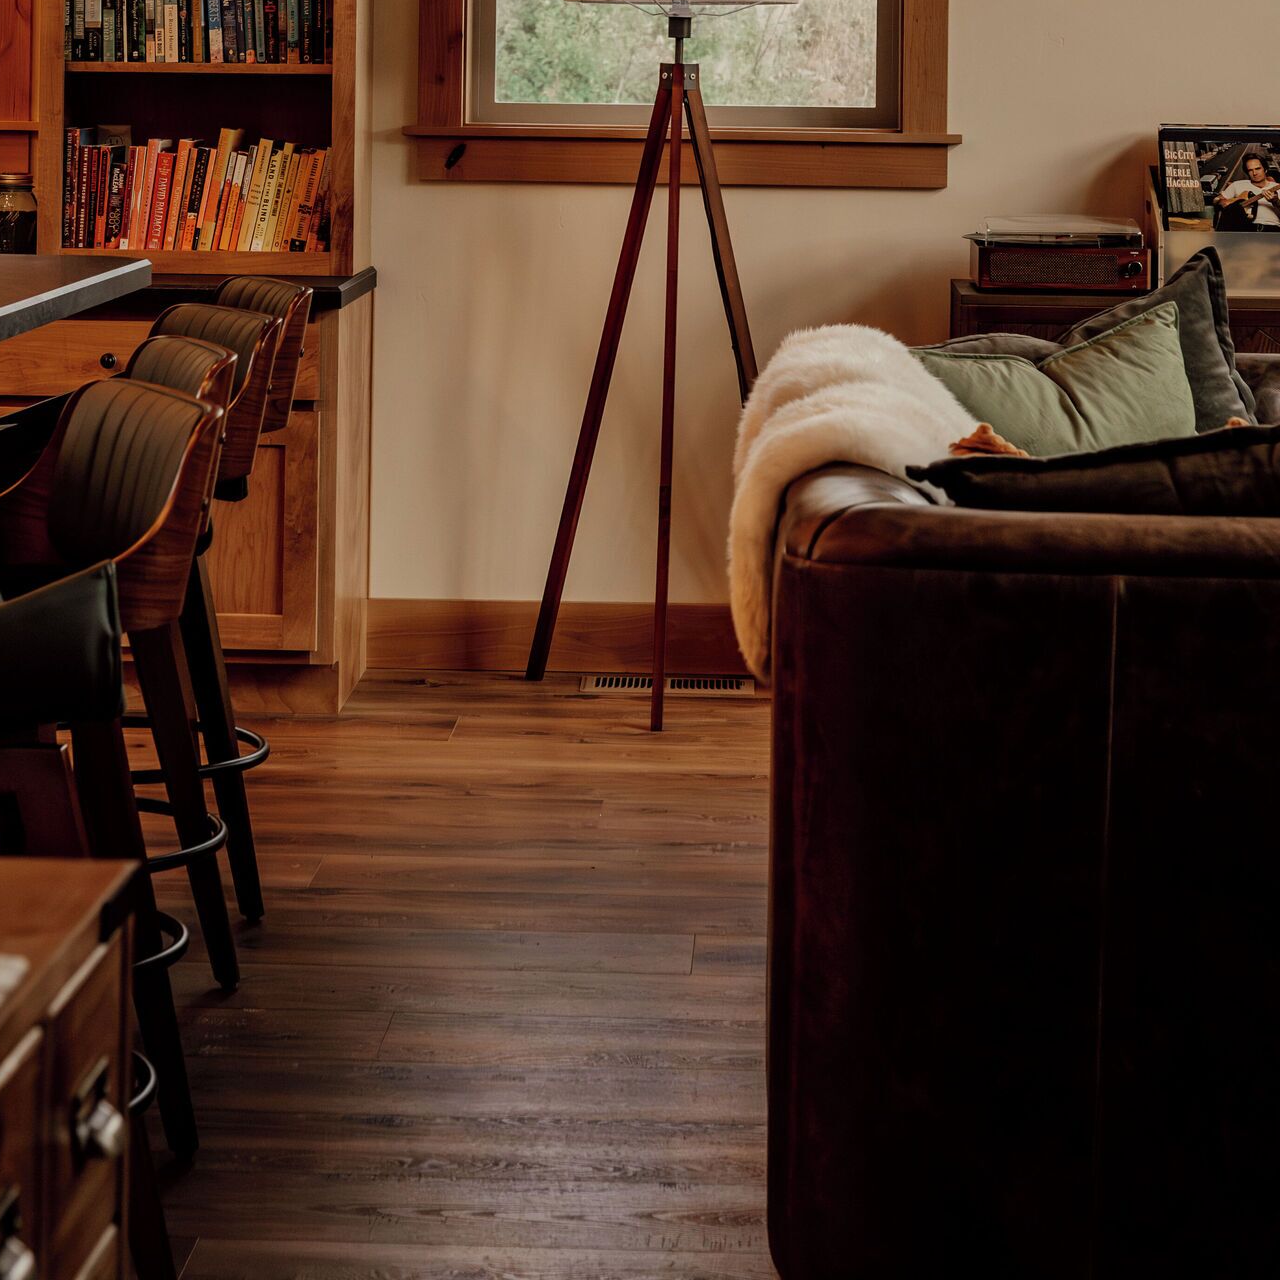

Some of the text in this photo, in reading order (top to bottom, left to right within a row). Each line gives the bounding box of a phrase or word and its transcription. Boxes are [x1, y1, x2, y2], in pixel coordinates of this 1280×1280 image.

[176, 150, 187, 180] Wintering
[1165, 149, 1195, 160] BIG CITY
[268, 159, 277, 180] LAND
[1165, 166, 1191, 177] MERLE
[158, 177, 168, 199] DAVID
[1166, 177, 1199, 188] HAGGARD
[112, 207, 120, 234] KNOCK
[151, 201, 165, 236] BALDACCI
[259, 198, 269, 222] BLIND
